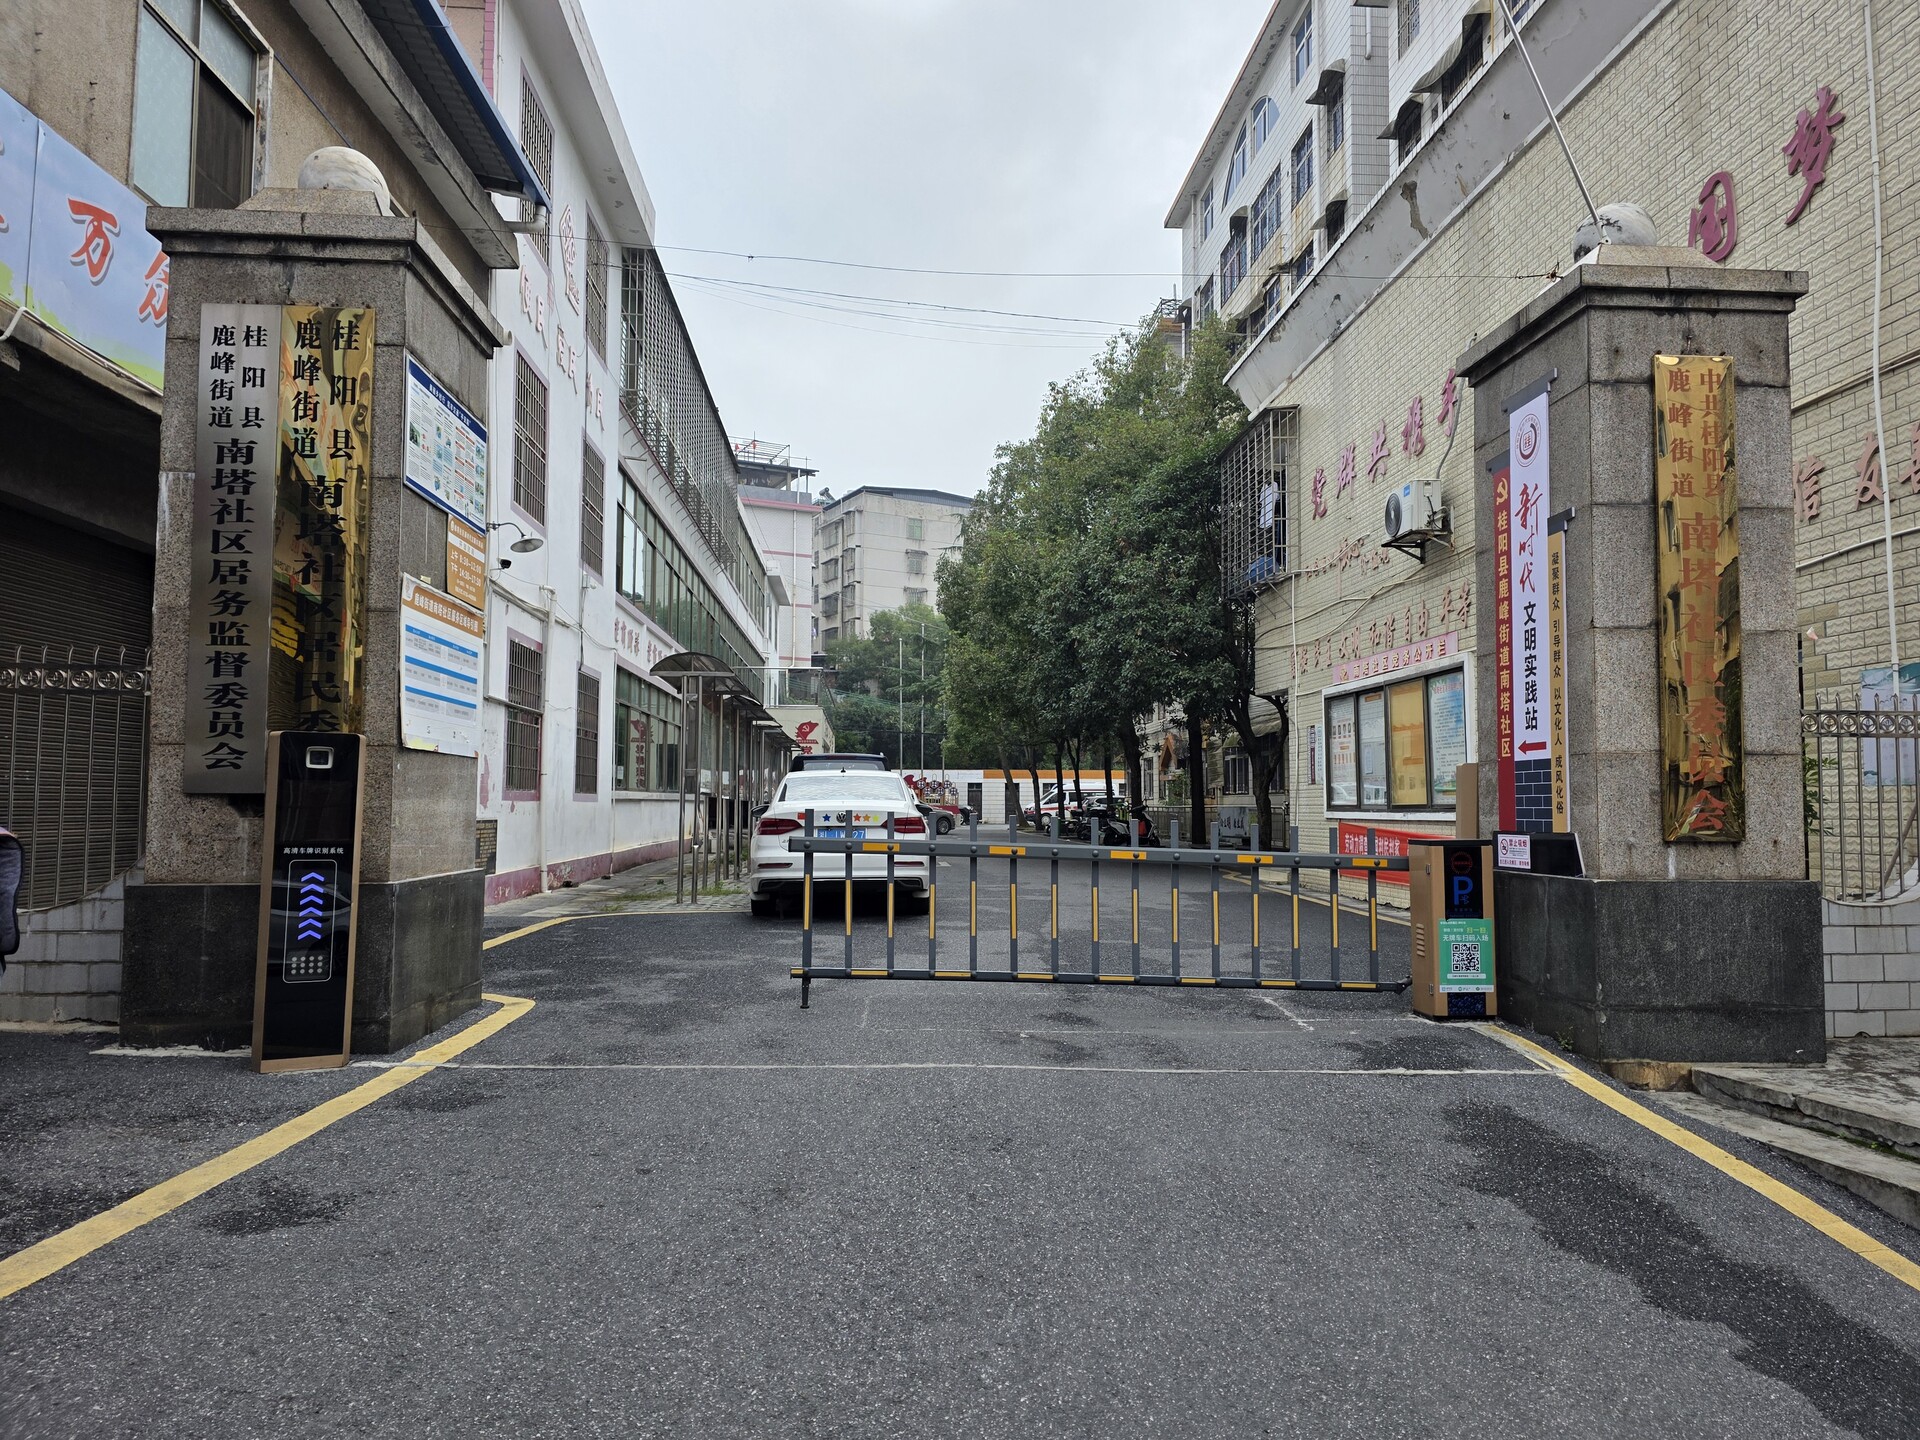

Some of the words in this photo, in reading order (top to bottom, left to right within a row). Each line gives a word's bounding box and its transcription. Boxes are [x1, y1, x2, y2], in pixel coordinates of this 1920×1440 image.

[208, 324, 236, 428] 鹿峰街道
[240, 324, 268, 429] 桂阳县
[290, 318, 322, 460] 鹿峰街道
[327, 319, 360, 461] 桂阳县
[1668, 368, 1695, 498] 鹿峰街道
[1700, 368, 1725, 499] 中共桂阳县
[1515, 483, 1543, 594] 新时代
[202, 438, 258, 770] 南塔社区居务监督委员会
[1339, 623, 1361, 659] 文明
[1369, 613, 1396, 651] 和谐
[1404, 600, 1430, 643] 自由
[1497, 511, 1511, 757] 桂阳县鹿峰街道南塔社区
[1553, 619, 1561, 679] 引导群众
[1524, 601, 1538, 731] 文明实践站
[1554, 687, 1562, 746] 以文化人
[1555, 755, 1564, 815] 成风化俗
[283, 846, 344, 855] 高清车牌识别系统
[1453, 876, 1474, 906] P
[1509, 838, 1528, 848] 禁止吸烟
[1443, 934, 1489, 942] 无牌车扫码入场
